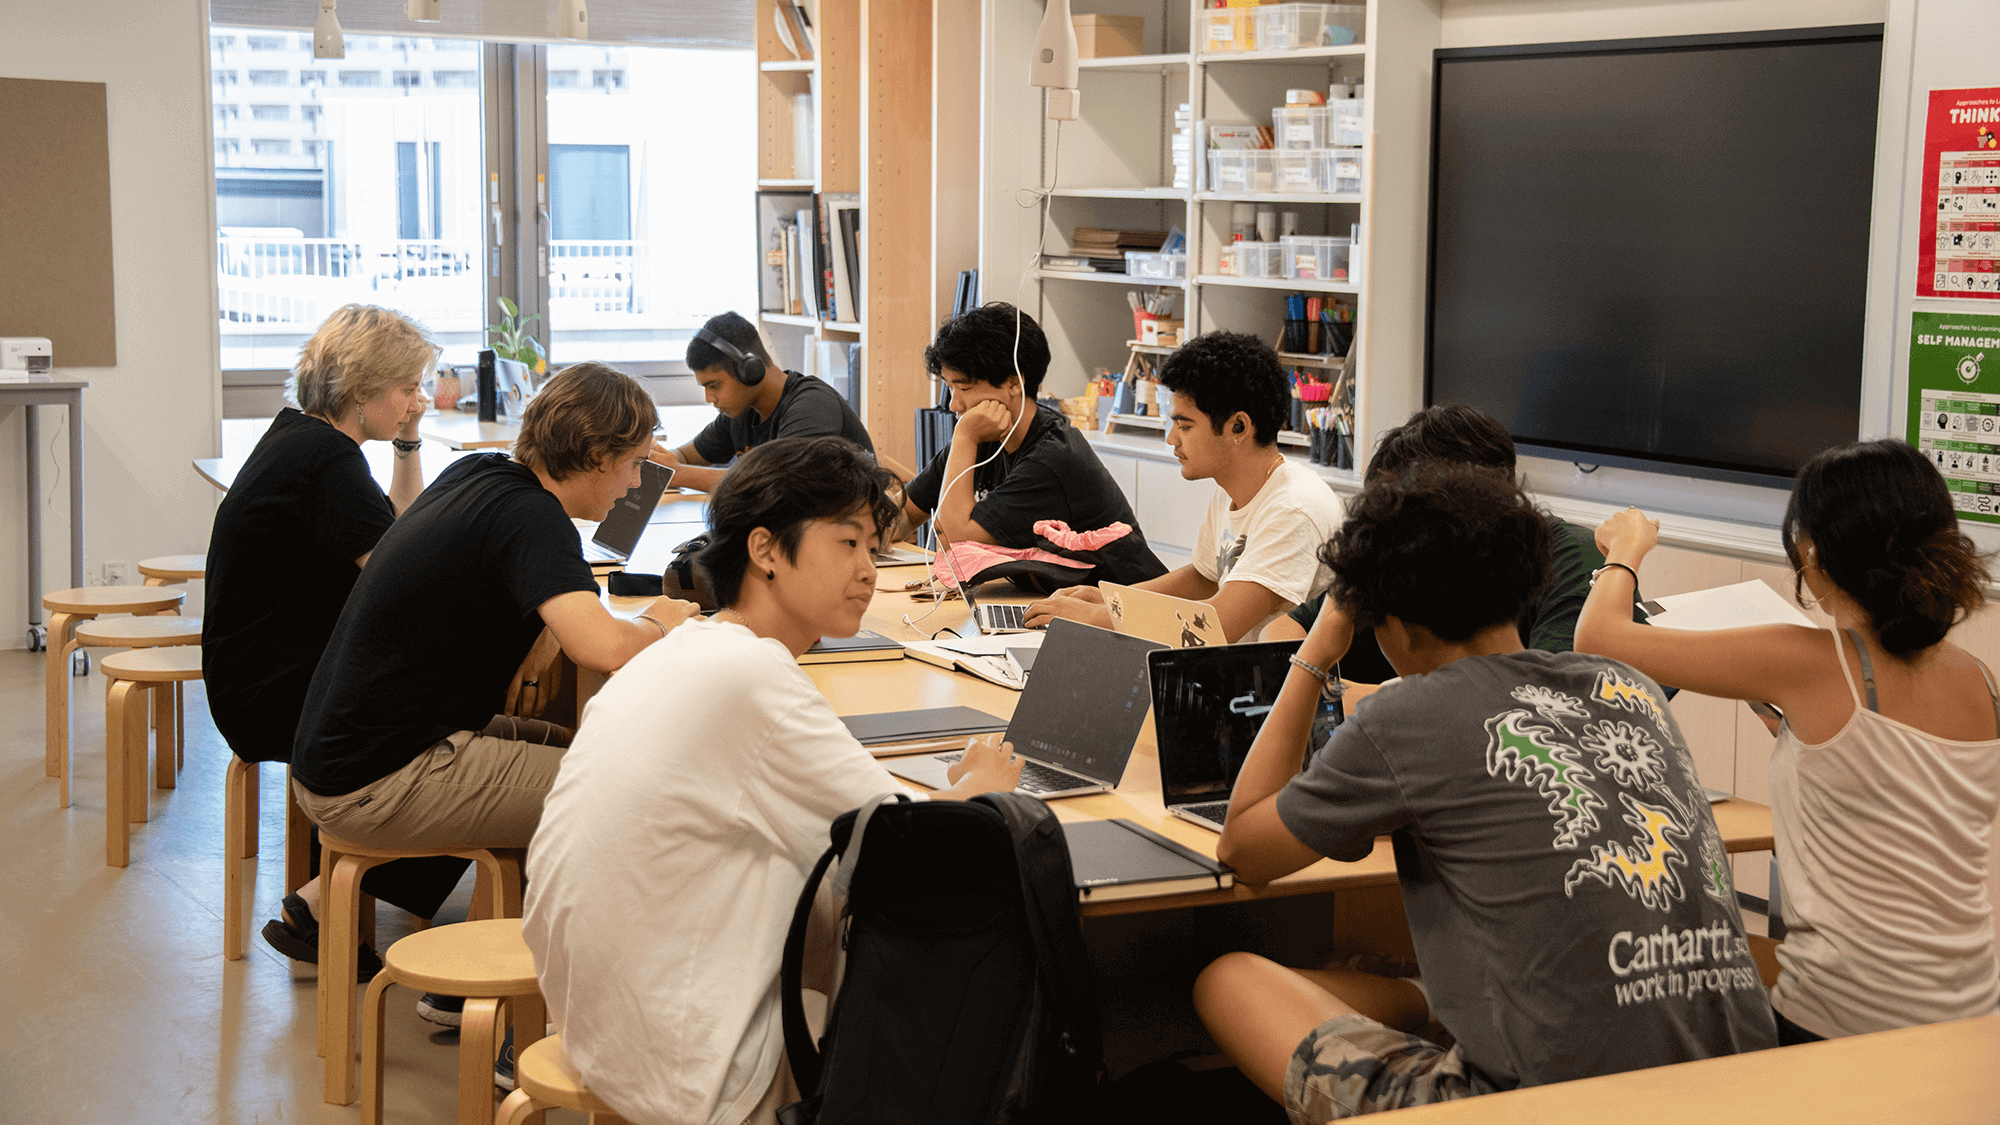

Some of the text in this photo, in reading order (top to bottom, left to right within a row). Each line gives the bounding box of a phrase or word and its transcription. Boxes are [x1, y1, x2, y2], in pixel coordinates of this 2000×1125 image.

[1956, 99, 1989, 107] Approaches
[1949, 107, 2000, 125] THINK
[1917, 334, 2000, 349] SELF MANAGEM
[1608, 918, 1732, 977] Carhartt
[1614, 966, 1755, 1007] work in progress
